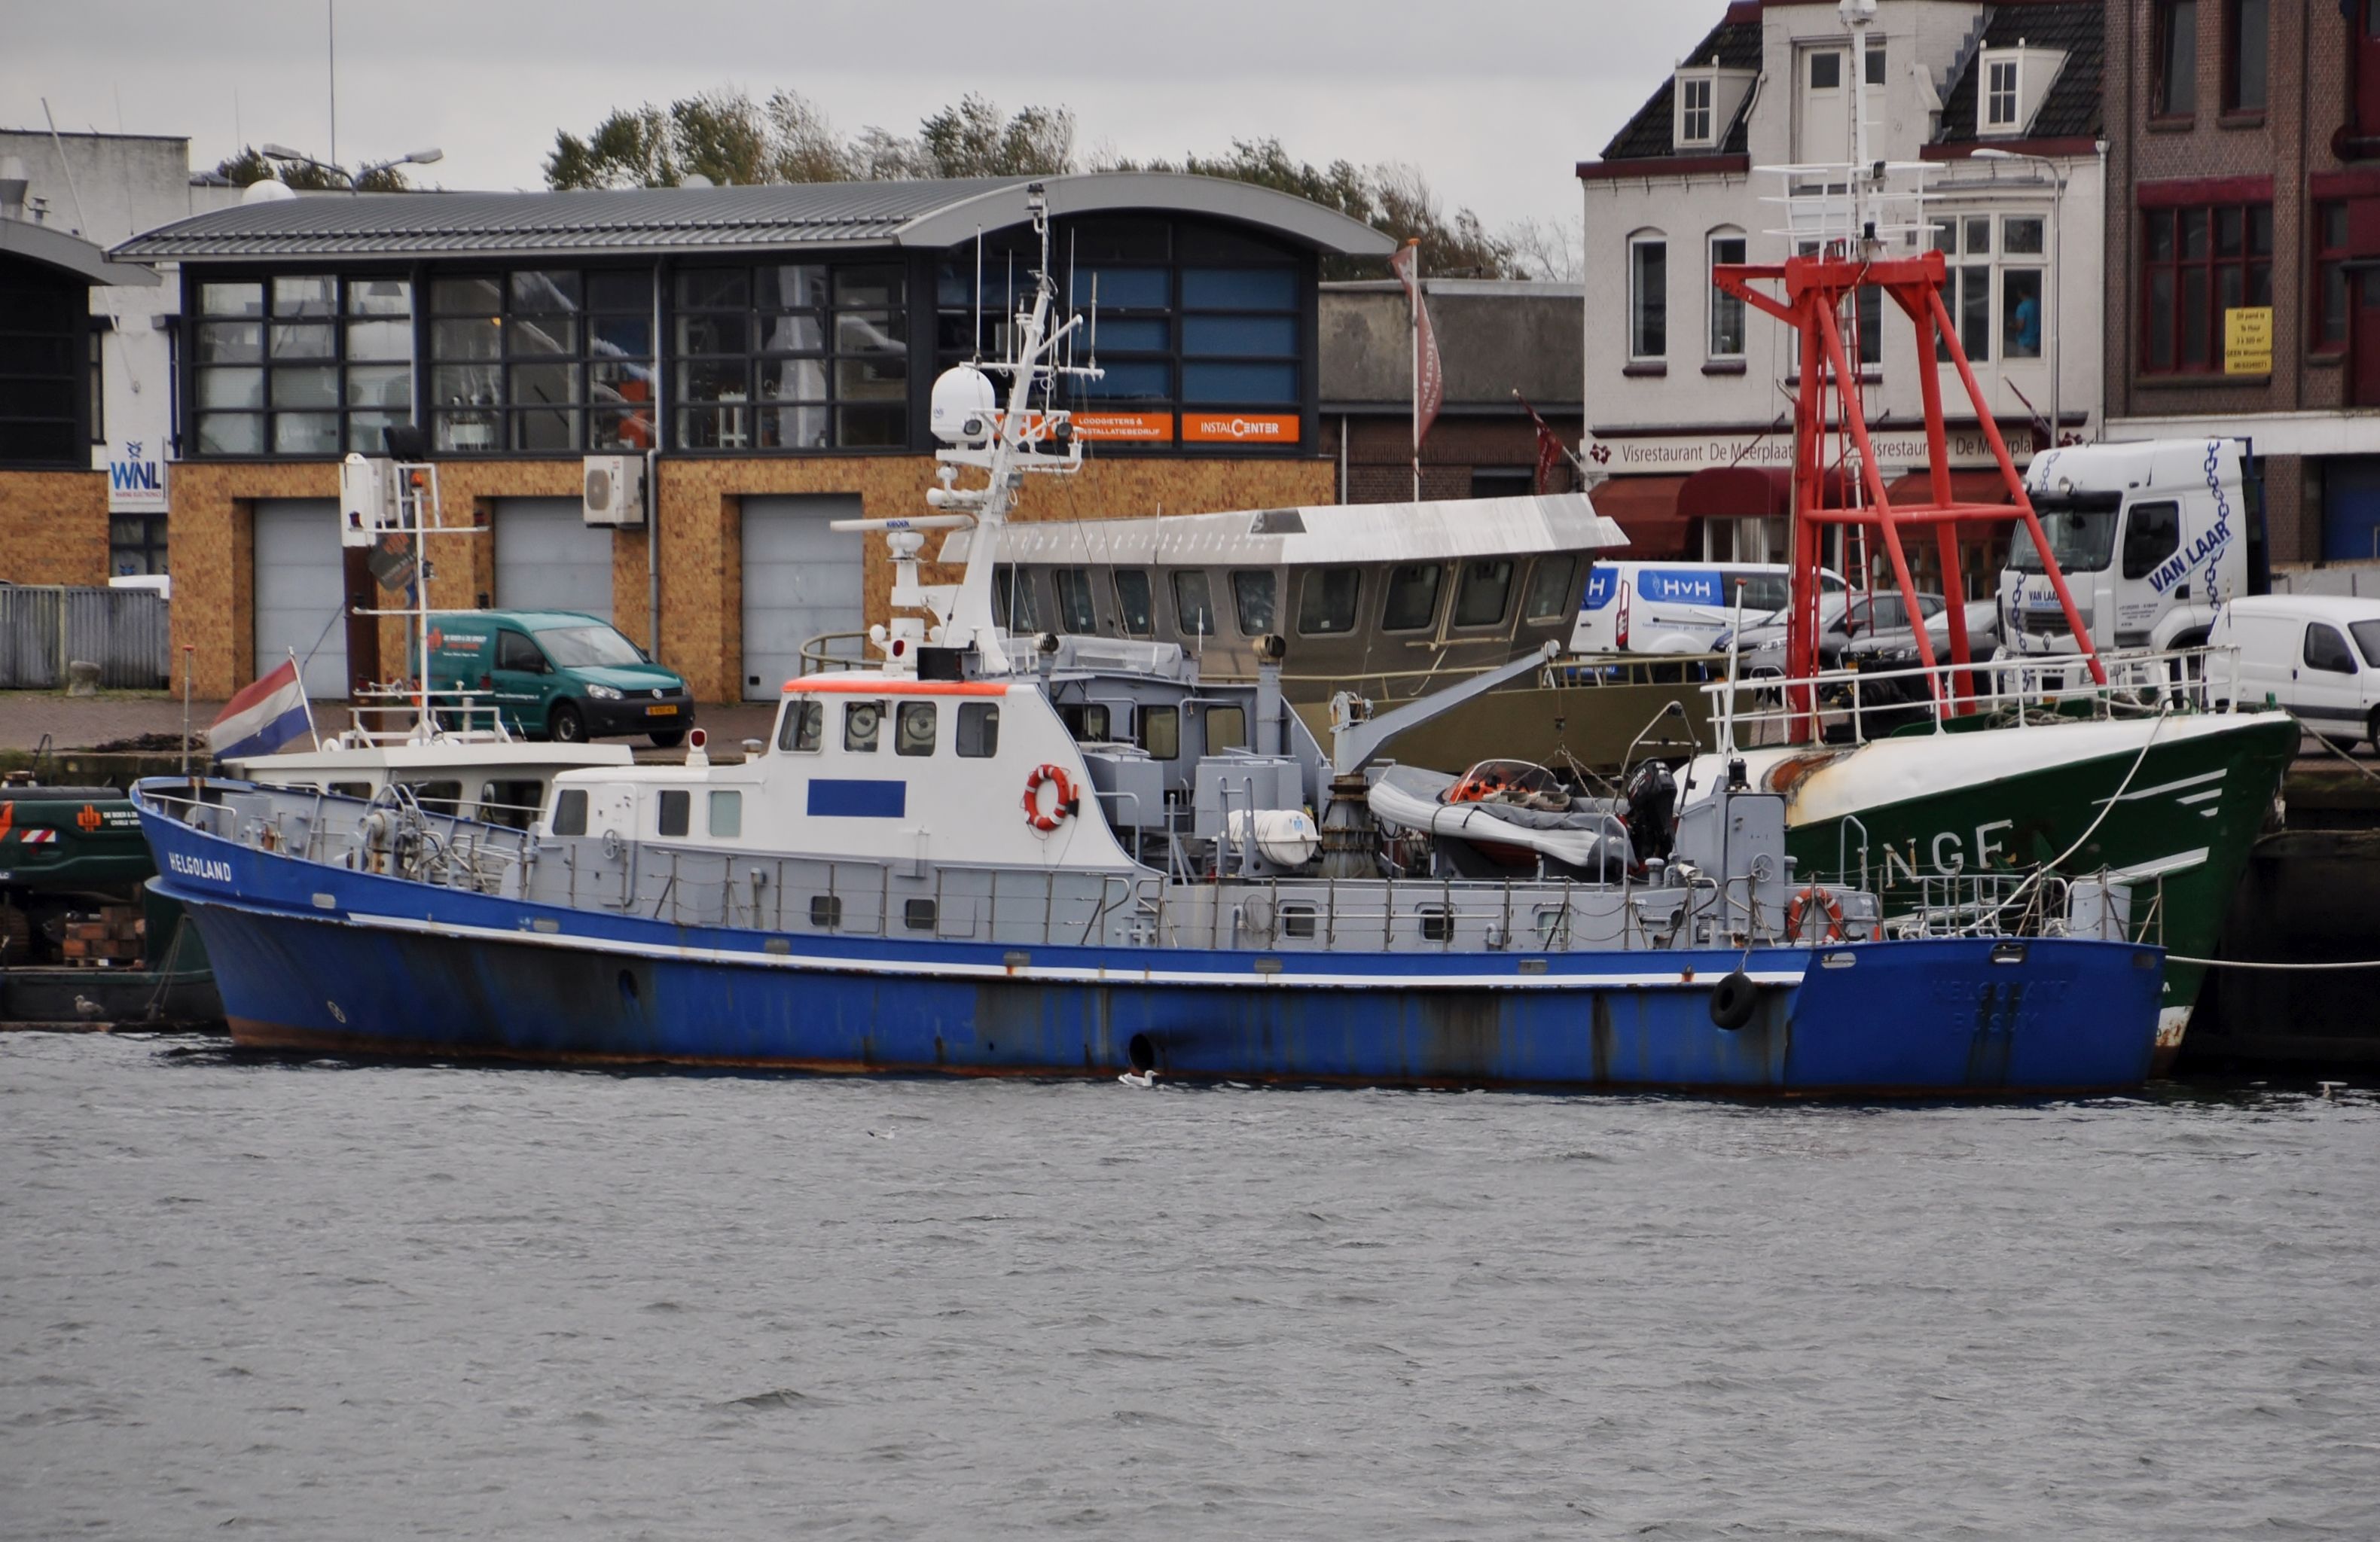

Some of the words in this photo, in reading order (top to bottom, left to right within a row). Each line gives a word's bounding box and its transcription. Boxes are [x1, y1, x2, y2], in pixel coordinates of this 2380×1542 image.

[1079, 417, 1135, 425] LOODGIETERS
[1622, 444, 1704, 462] Visrestaurant
[1709, 442, 1727, 461] De
[1956, 436, 1975, 456] De
[110, 461, 162, 490] WNL
[2148, 555, 2187, 593] VAN
[2185, 520, 2232, 565] LAAR
[1663, 578, 1711, 599] HvH
[2028, 590, 2043, 602] VAN
[168, 852, 232, 882] HELGOLAND
